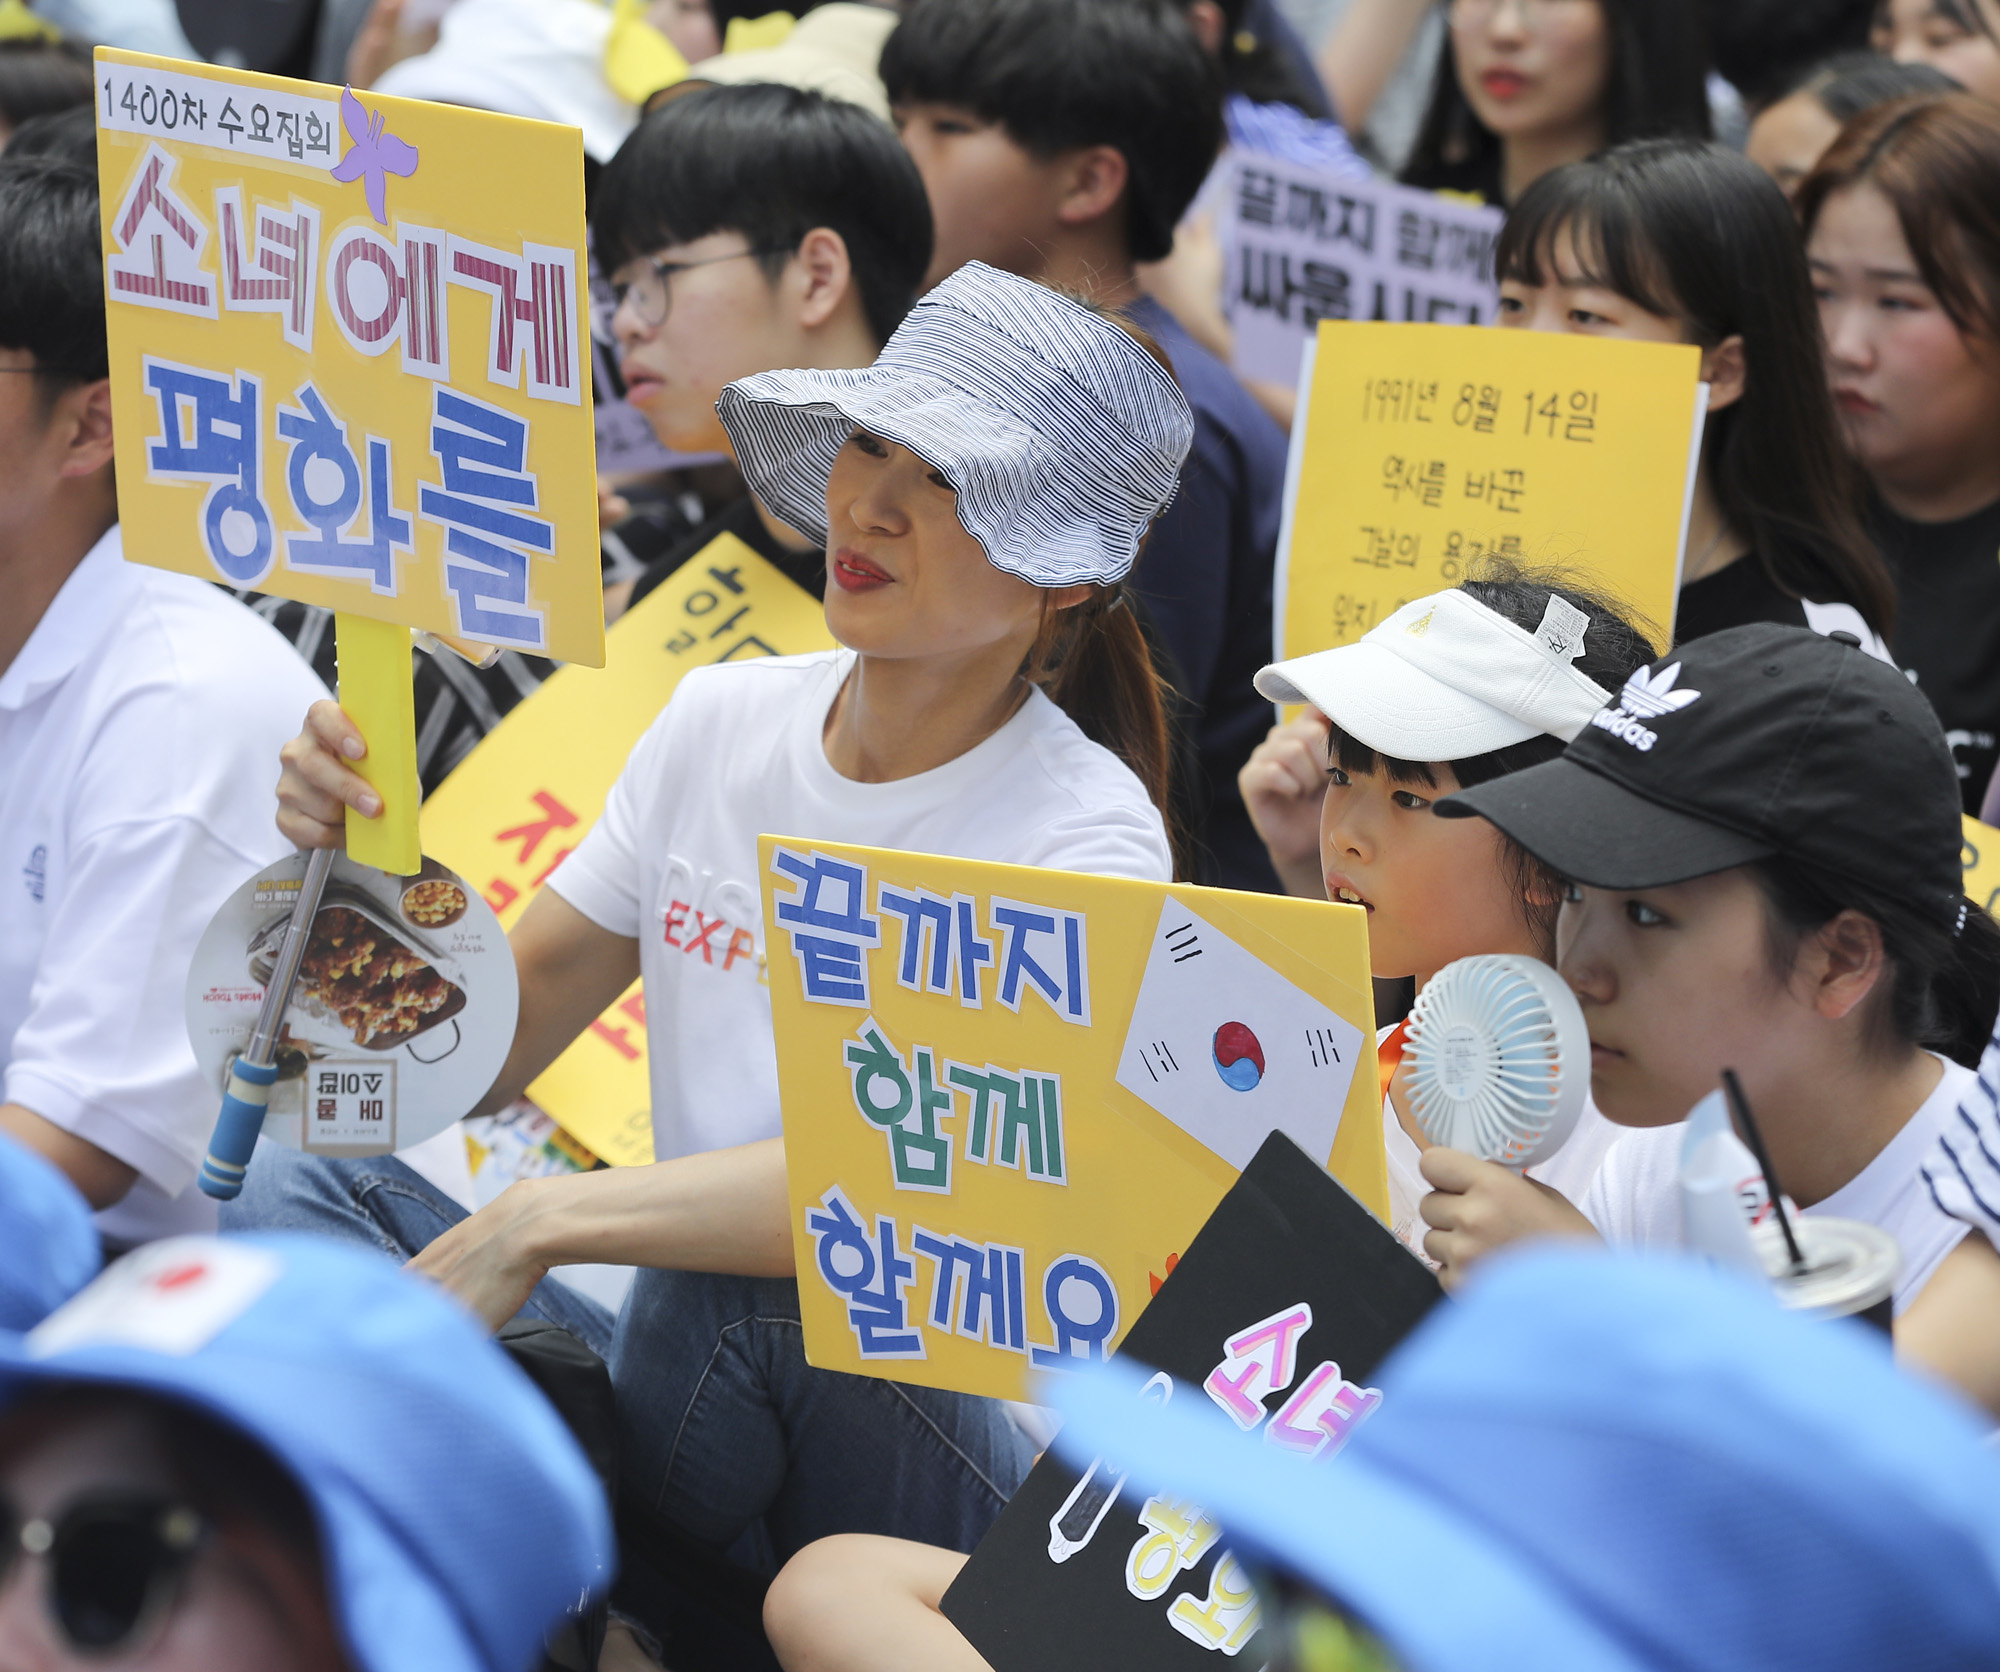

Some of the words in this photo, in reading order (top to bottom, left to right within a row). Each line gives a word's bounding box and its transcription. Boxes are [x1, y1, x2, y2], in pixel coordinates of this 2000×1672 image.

[103, 77, 208, 132] 1400차
[217, 96, 332, 159] 수요집회
[111, 152, 573, 391] 소녀에게
[1239, 168, 1376, 254] 끝까지
[1398, 210, 1494, 282] 함께
[1362, 376, 1439, 424] 1991년
[1451, 384, 1501, 434] 8월
[1522, 389, 1600, 444] 14일
[146, 363, 552, 644] 평화를
[1382, 455, 1447, 509] 역사를
[1464, 469, 1526, 514] 바꾼
[1352, 526, 1422, 570] 그날의
[658, 853, 765, 958] DIS
[775, 850, 1083, 1018] 끝까지
[846, 1027, 1063, 1189] 함께
[809, 1196, 1116, 1374] 할께요
